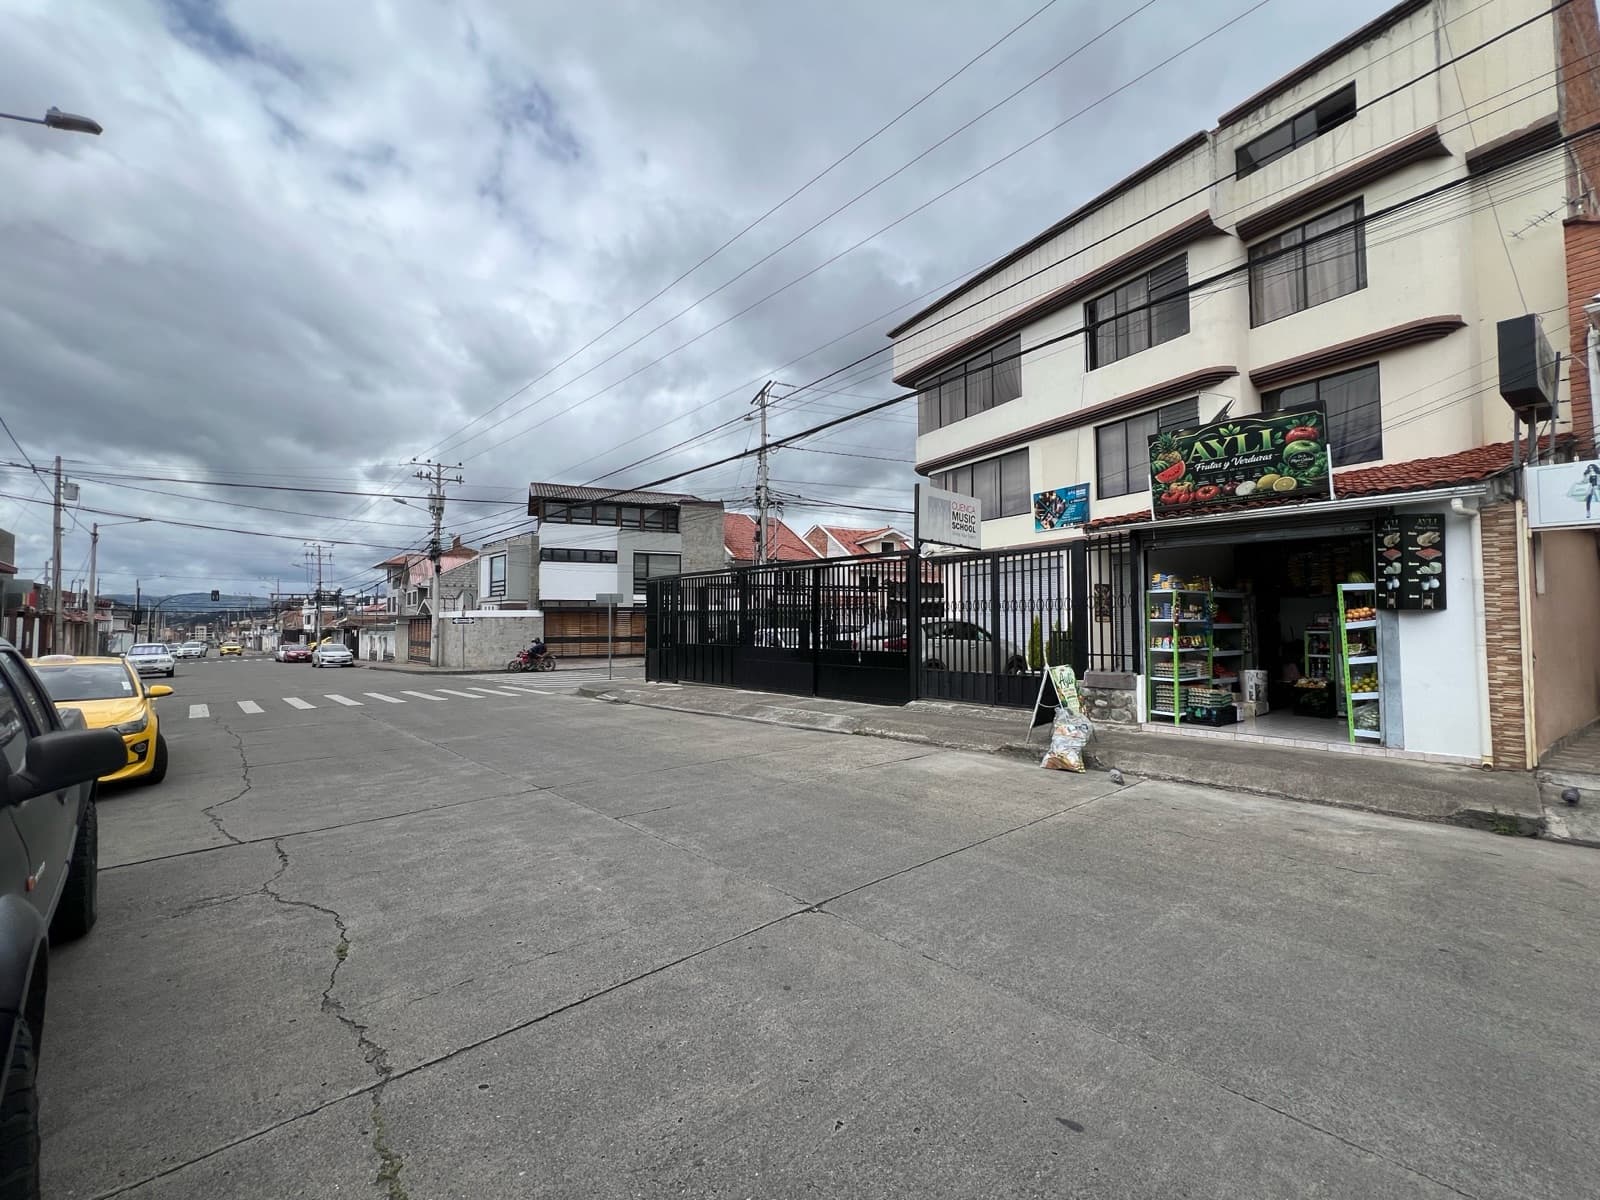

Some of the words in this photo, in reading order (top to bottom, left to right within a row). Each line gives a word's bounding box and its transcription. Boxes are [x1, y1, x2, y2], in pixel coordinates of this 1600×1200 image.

[1186, 428, 1275, 464] AYLI
[1195, 461, 1222, 472] Frutas
[1223, 461, 1230, 470] y
[1231, 453, 1273, 466] Verduras
[952, 511, 976, 525] MUSIC
[952, 521, 976, 534] SCHOOL
